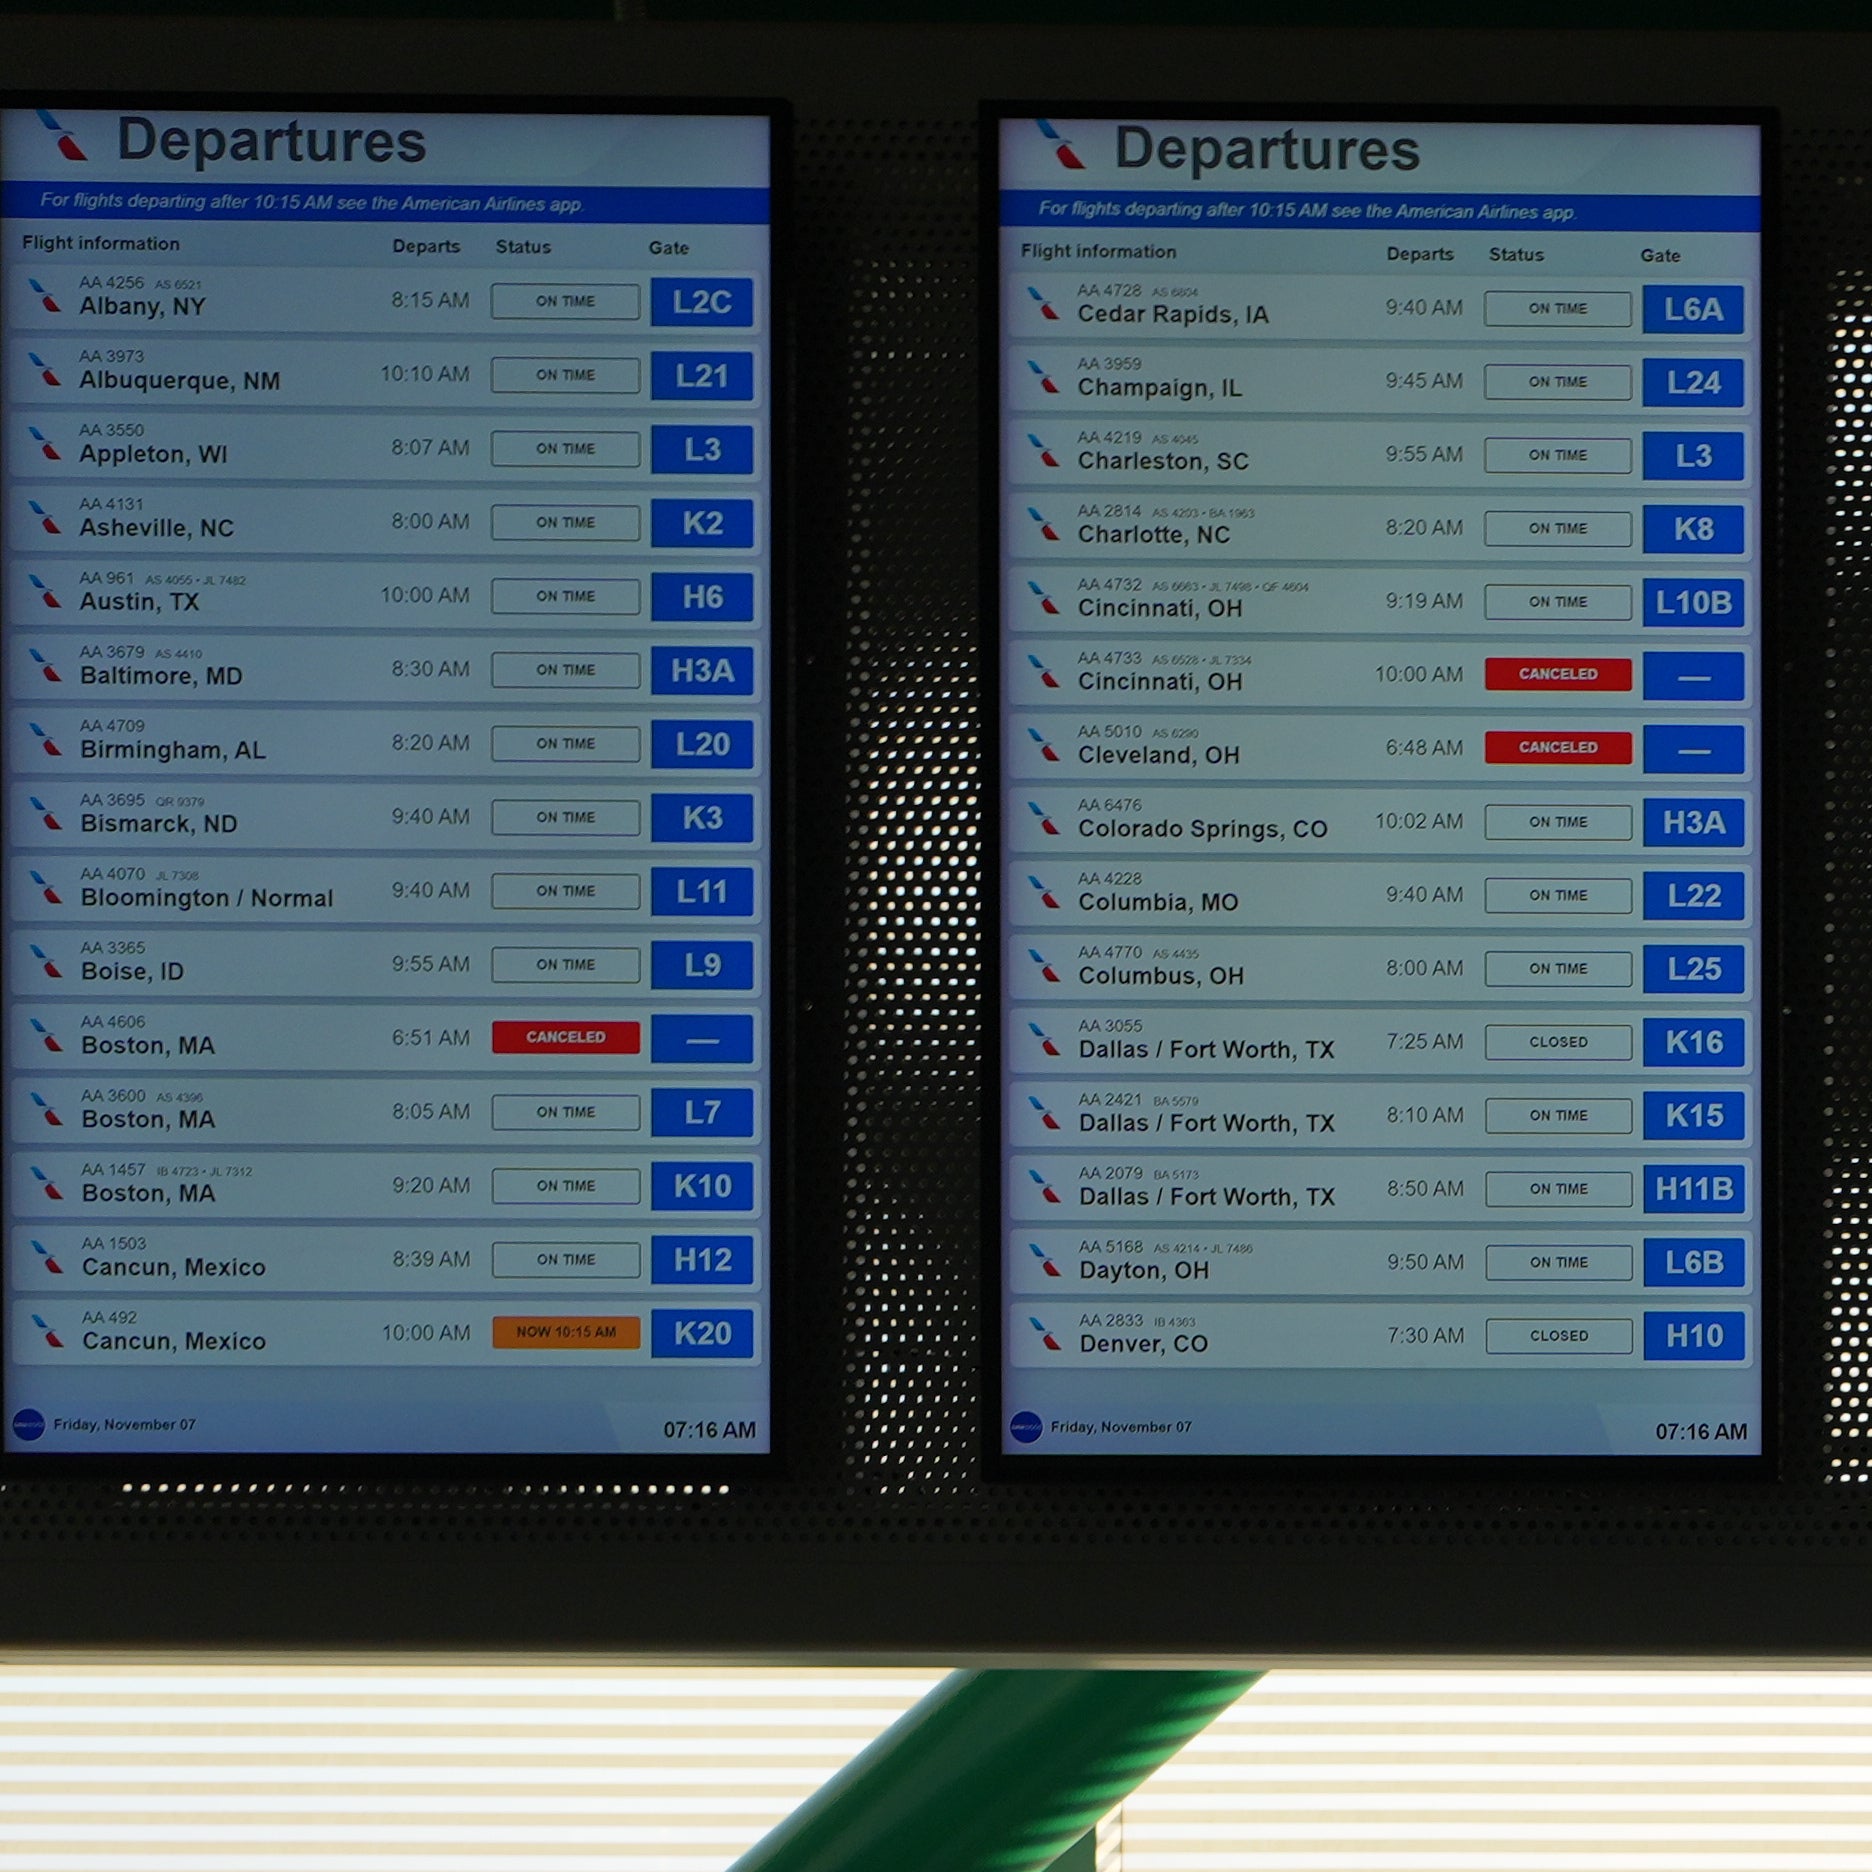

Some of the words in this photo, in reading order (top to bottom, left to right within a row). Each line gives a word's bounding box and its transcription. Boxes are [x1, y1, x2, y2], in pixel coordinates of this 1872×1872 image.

[118, 115, 428, 174] Departures
[1116, 124, 1422, 181] Departures
[40, 191, 71, 207] For
[73, 191, 123, 211] flights
[127, 193, 207, 212] departing
[209, 193, 250, 209] after
[254, 193, 301, 210] 10:15
[302, 194, 334, 210] AM
[336, 198, 368, 211] see
[371, 195, 399, 211] the
[400, 195, 481, 212] American
[482, 195, 546, 212] Airlines
[549, 199, 584, 216] app.
[22, 234, 74, 254] Flight
[78, 235, 180, 251] information
[392, 238, 462, 257] Departs
[495, 238, 552, 255] Status
[648, 240, 690, 256] Gate
[78, 275, 103, 289] AA
[105, 274, 145, 290] 4256
[79, 295, 165, 321] Albany,
[173, 296, 207, 316] NY
[391, 290, 434, 309] 8:15
[437, 291, 470, 309] AM
[535, 294, 558, 308] ON
[561, 295, 596, 308] TIME
[673, 289, 733, 314] L2C
[1078, 303, 1147, 323] Cedar
[1153, 304, 1238, 329] Rapids,
[1246, 305, 1270, 324] IA
[78, 369, 236, 395] Albuquerque,
[244, 371, 280, 391] NM
[381, 364, 434, 382] 10:10
[437, 365, 470, 382] AM
[676, 363, 727, 388] L21
[1668, 369, 1722, 395] L24
[1078, 377, 1214, 402] Champaign,
[1222, 378, 1243, 398] IL
[1078, 524, 1189, 548] Charlotte,
[1197, 525, 1231, 544] NC
[1675, 516, 1715, 541] K8
[1078, 818, 1183, 838] Colorado
[1190, 819, 1285, 843] Springs,
[1293, 819, 1328, 838] CO
[1376, 812, 1427, 830] 10:02
[1431, 812, 1463, 830] AM
[1663, 809, 1727, 835] H3A
[392, 1028, 431, 1046] 6:51
[438, 1028, 470, 1046] AM
[526, 1030, 607, 1044] CANCELED
[1529, 1035, 1589, 1048] CLOSED
[1080, 1260, 1167, 1284] Dayton,
[1174, 1260, 1209, 1280] OH
[1666, 1249, 1725, 1274] L6B
[82, 1331, 177, 1354] Cancun,
[185, 1331, 267, 1351] Mexico
[383, 1323, 434, 1342] 10:00
[438, 1324, 471, 1342] AM
[516, 1325, 552, 1338] NOW
[554, 1325, 592, 1338] 10:15
[593, 1325, 617, 1338] AM
[675, 1320, 732, 1346] K20
[53, 1418, 101, 1434] Friday,
[104, 1418, 177, 1431] November
[179, 1418, 197, 1431] 07
[663, 1420, 718, 1439] 07:16
[722, 1421, 756, 1439] AM
